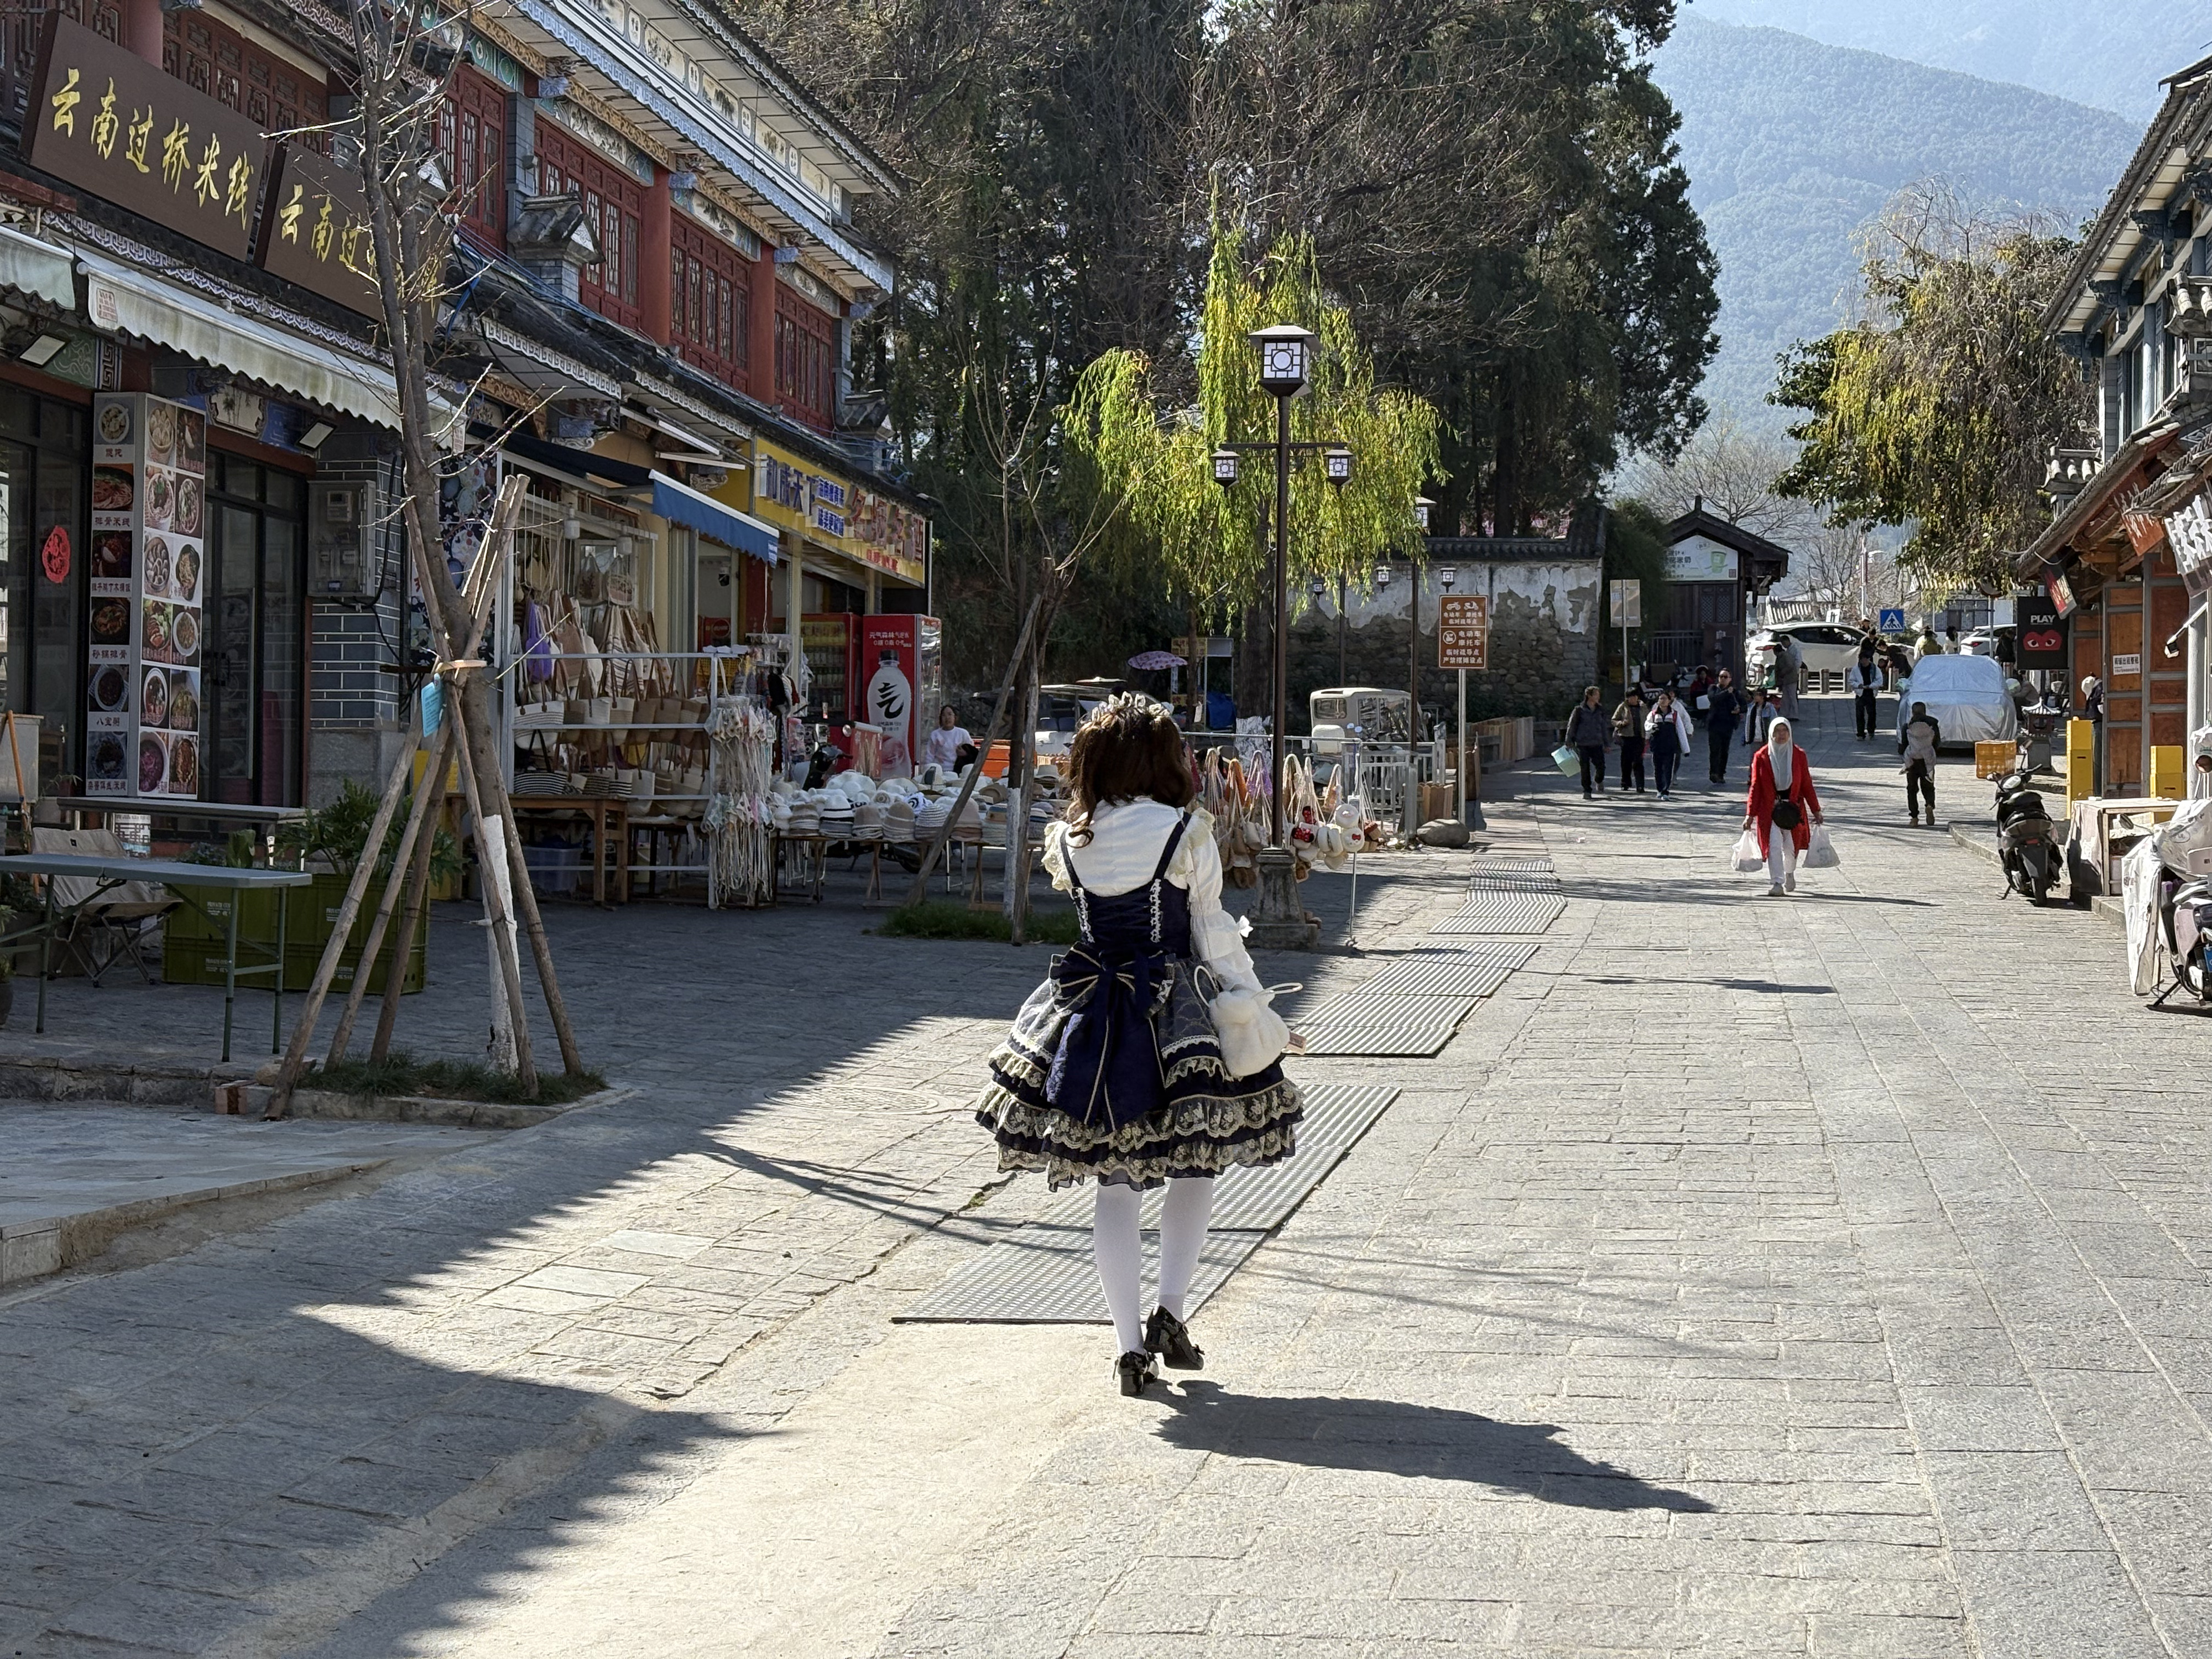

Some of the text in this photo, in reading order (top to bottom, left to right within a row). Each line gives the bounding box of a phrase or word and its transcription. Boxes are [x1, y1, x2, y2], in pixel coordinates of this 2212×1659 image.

[52, 67, 254, 231] 云南过桥米线
[764, 454, 816, 516] 和成天下
[94, 517, 131, 528] 排骨米线
[851, 486, 924, 565] 名烟名酒
[2030, 615, 2056, 623] PLAY
[92, 649, 127, 660] 砂锅排骨
[96, 716, 120, 727] 八宝粥
